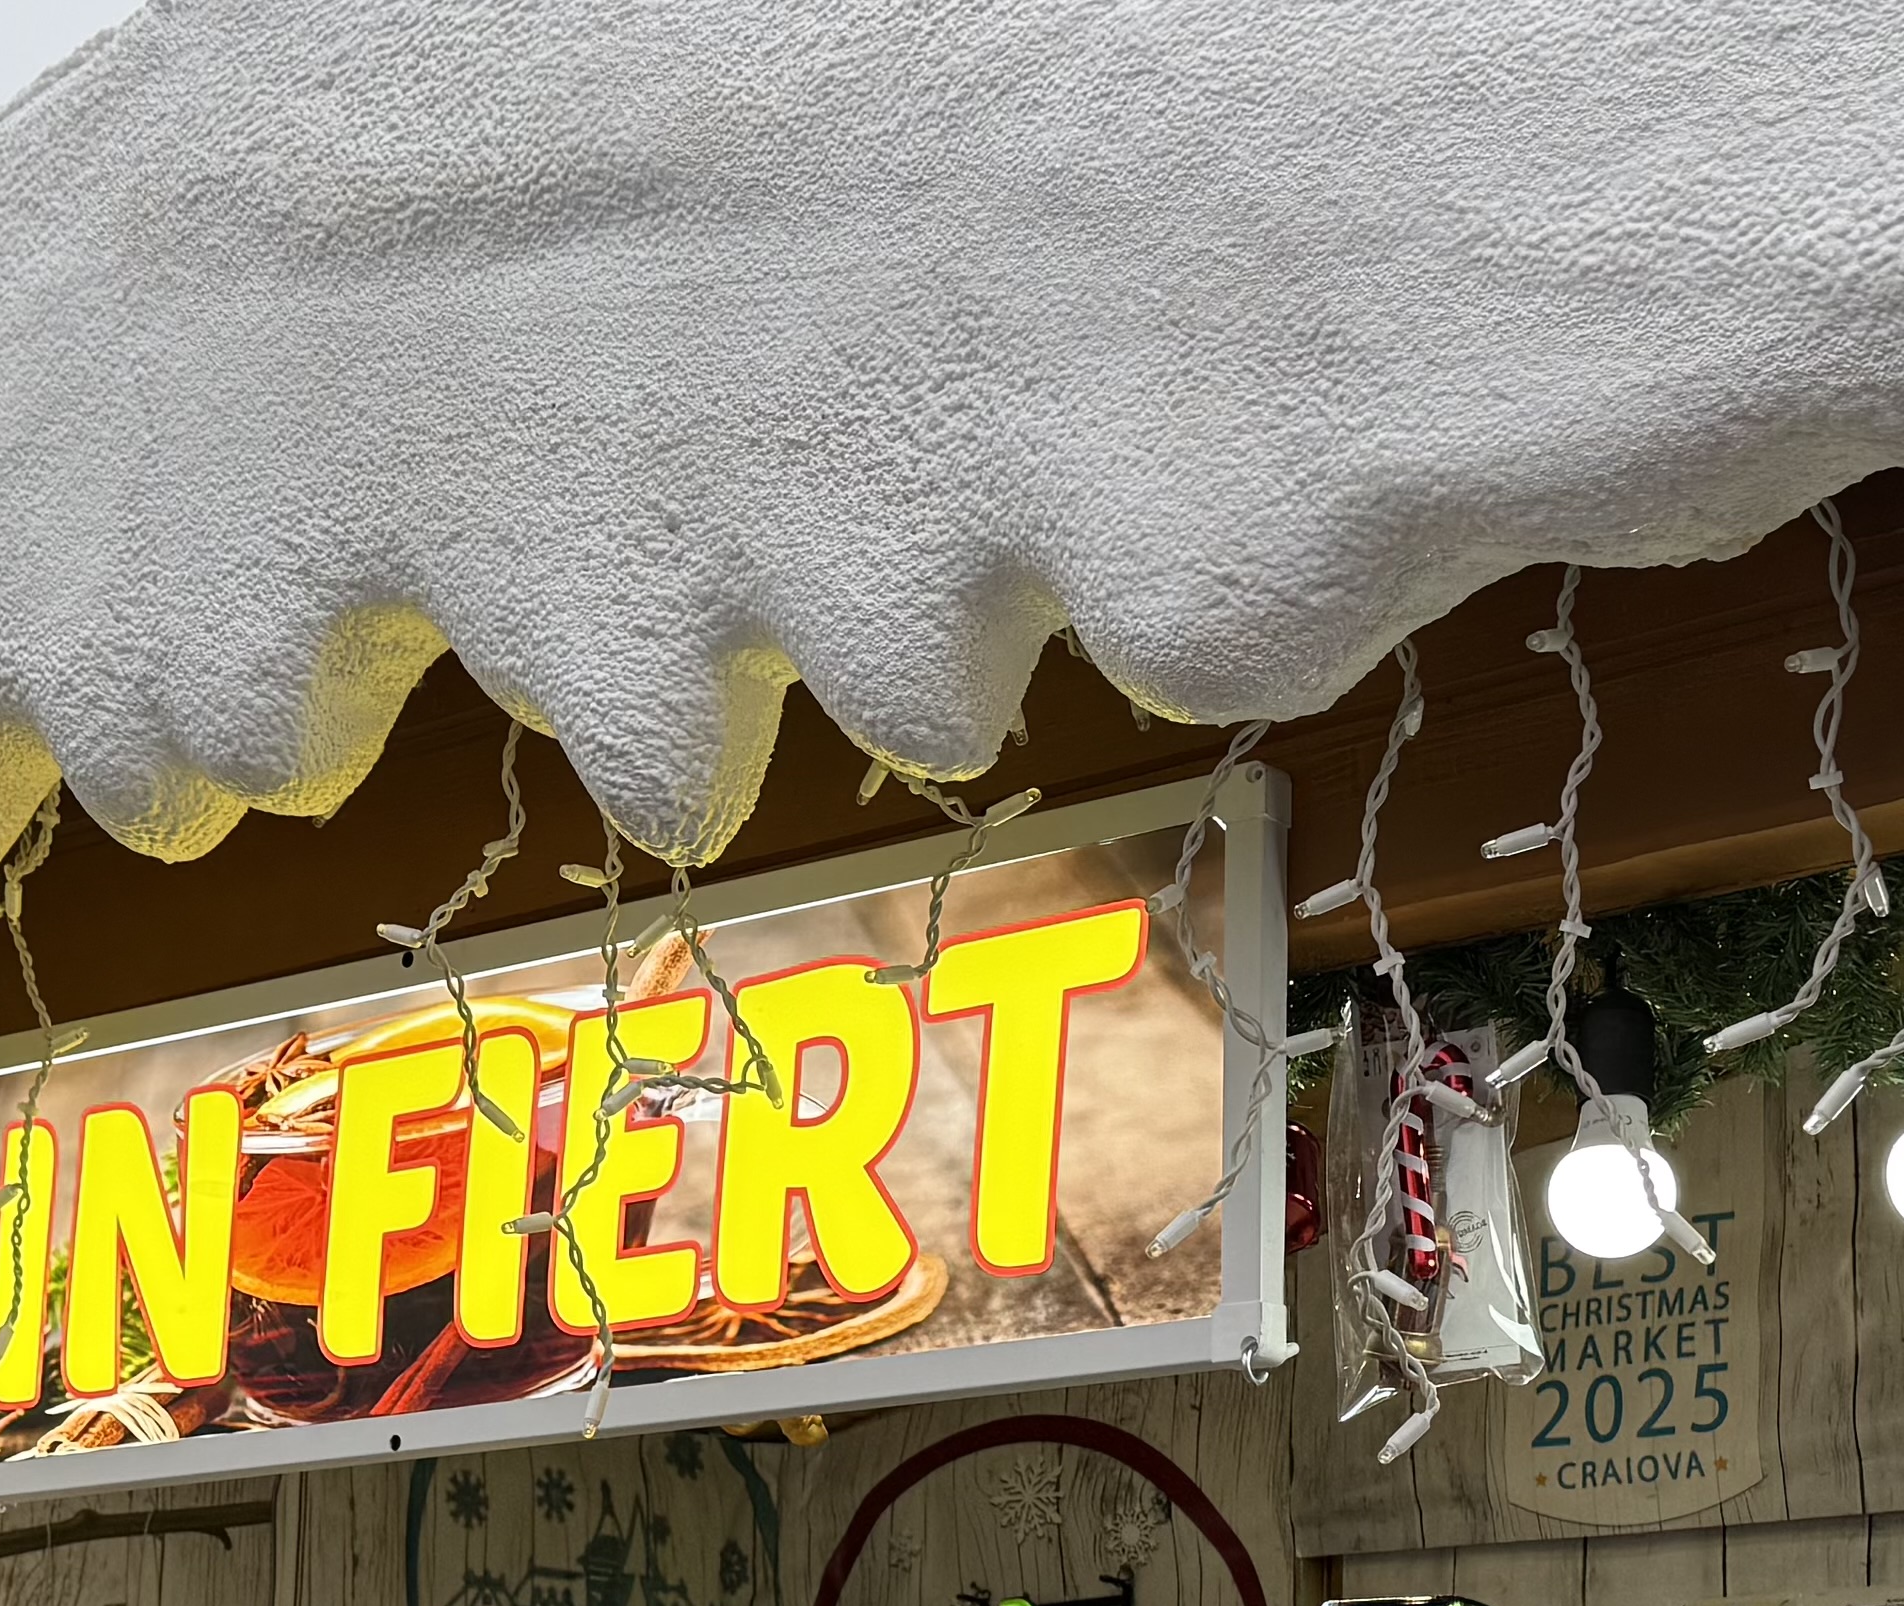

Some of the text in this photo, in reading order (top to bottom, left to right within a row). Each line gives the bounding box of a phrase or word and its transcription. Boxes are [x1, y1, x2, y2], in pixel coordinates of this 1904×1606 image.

[319, 898, 1149, 1366] FIERT
[1540, 1281, 1729, 1332] CHRISTMAS
[1542, 1319, 1729, 1373] MARKET
[1531, 1363, 1728, 1448] 2025
[1557, 1451, 1706, 1489] CRAIOVA
